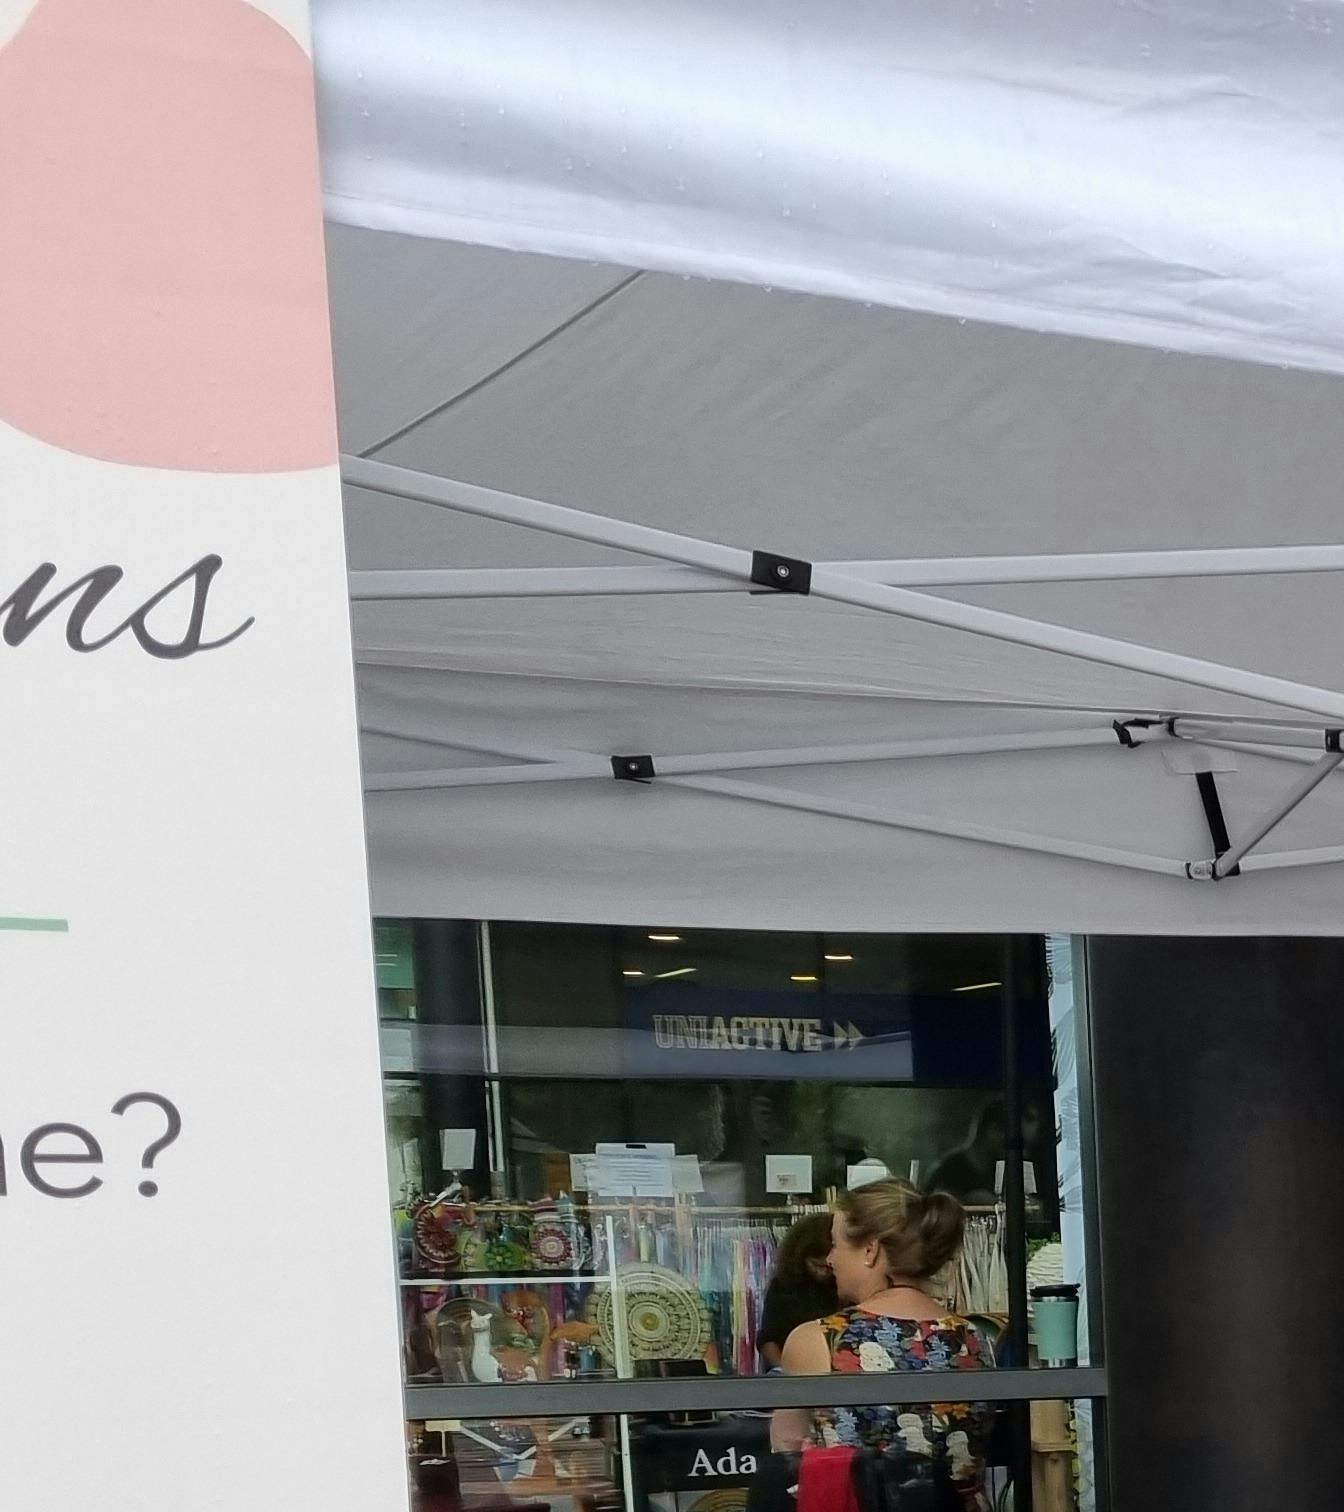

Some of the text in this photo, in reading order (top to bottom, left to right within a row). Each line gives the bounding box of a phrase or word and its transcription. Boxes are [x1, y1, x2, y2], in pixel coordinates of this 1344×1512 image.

[0, 553, 255, 660] ns
[652, 1014, 823, 1052] UNIACTIVE
[0, 1091, 182, 1199] e?
[687, 1446, 758, 1477] Ada
